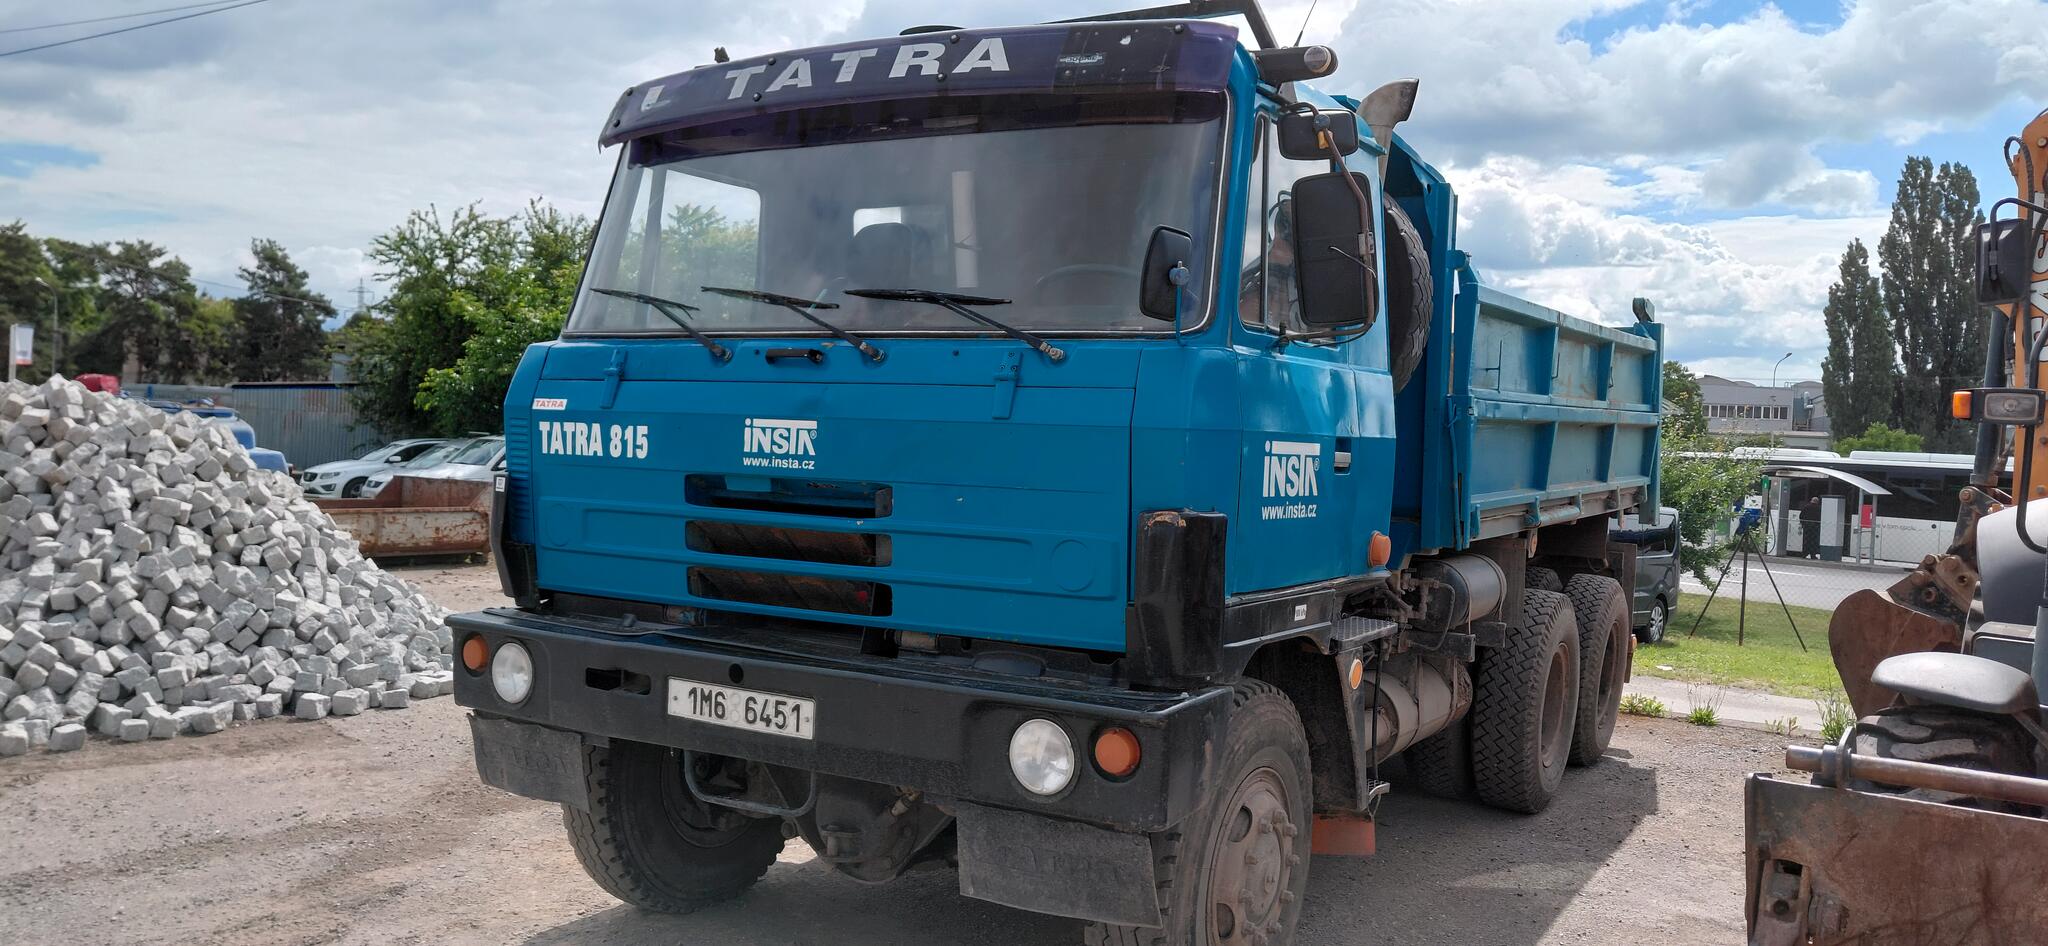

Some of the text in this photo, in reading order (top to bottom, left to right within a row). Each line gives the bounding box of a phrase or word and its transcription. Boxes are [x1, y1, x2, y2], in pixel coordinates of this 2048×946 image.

[725, 38, 1010, 100] TATRA
[535, 399, 564, 408] TATRA
[539, 421, 648, 459] TATRA 815
[743, 456, 815, 470] www.insta.cz
[1261, 501, 1317, 520] www.insta.cz
[688, 686, 801, 733] 1M6 6451
